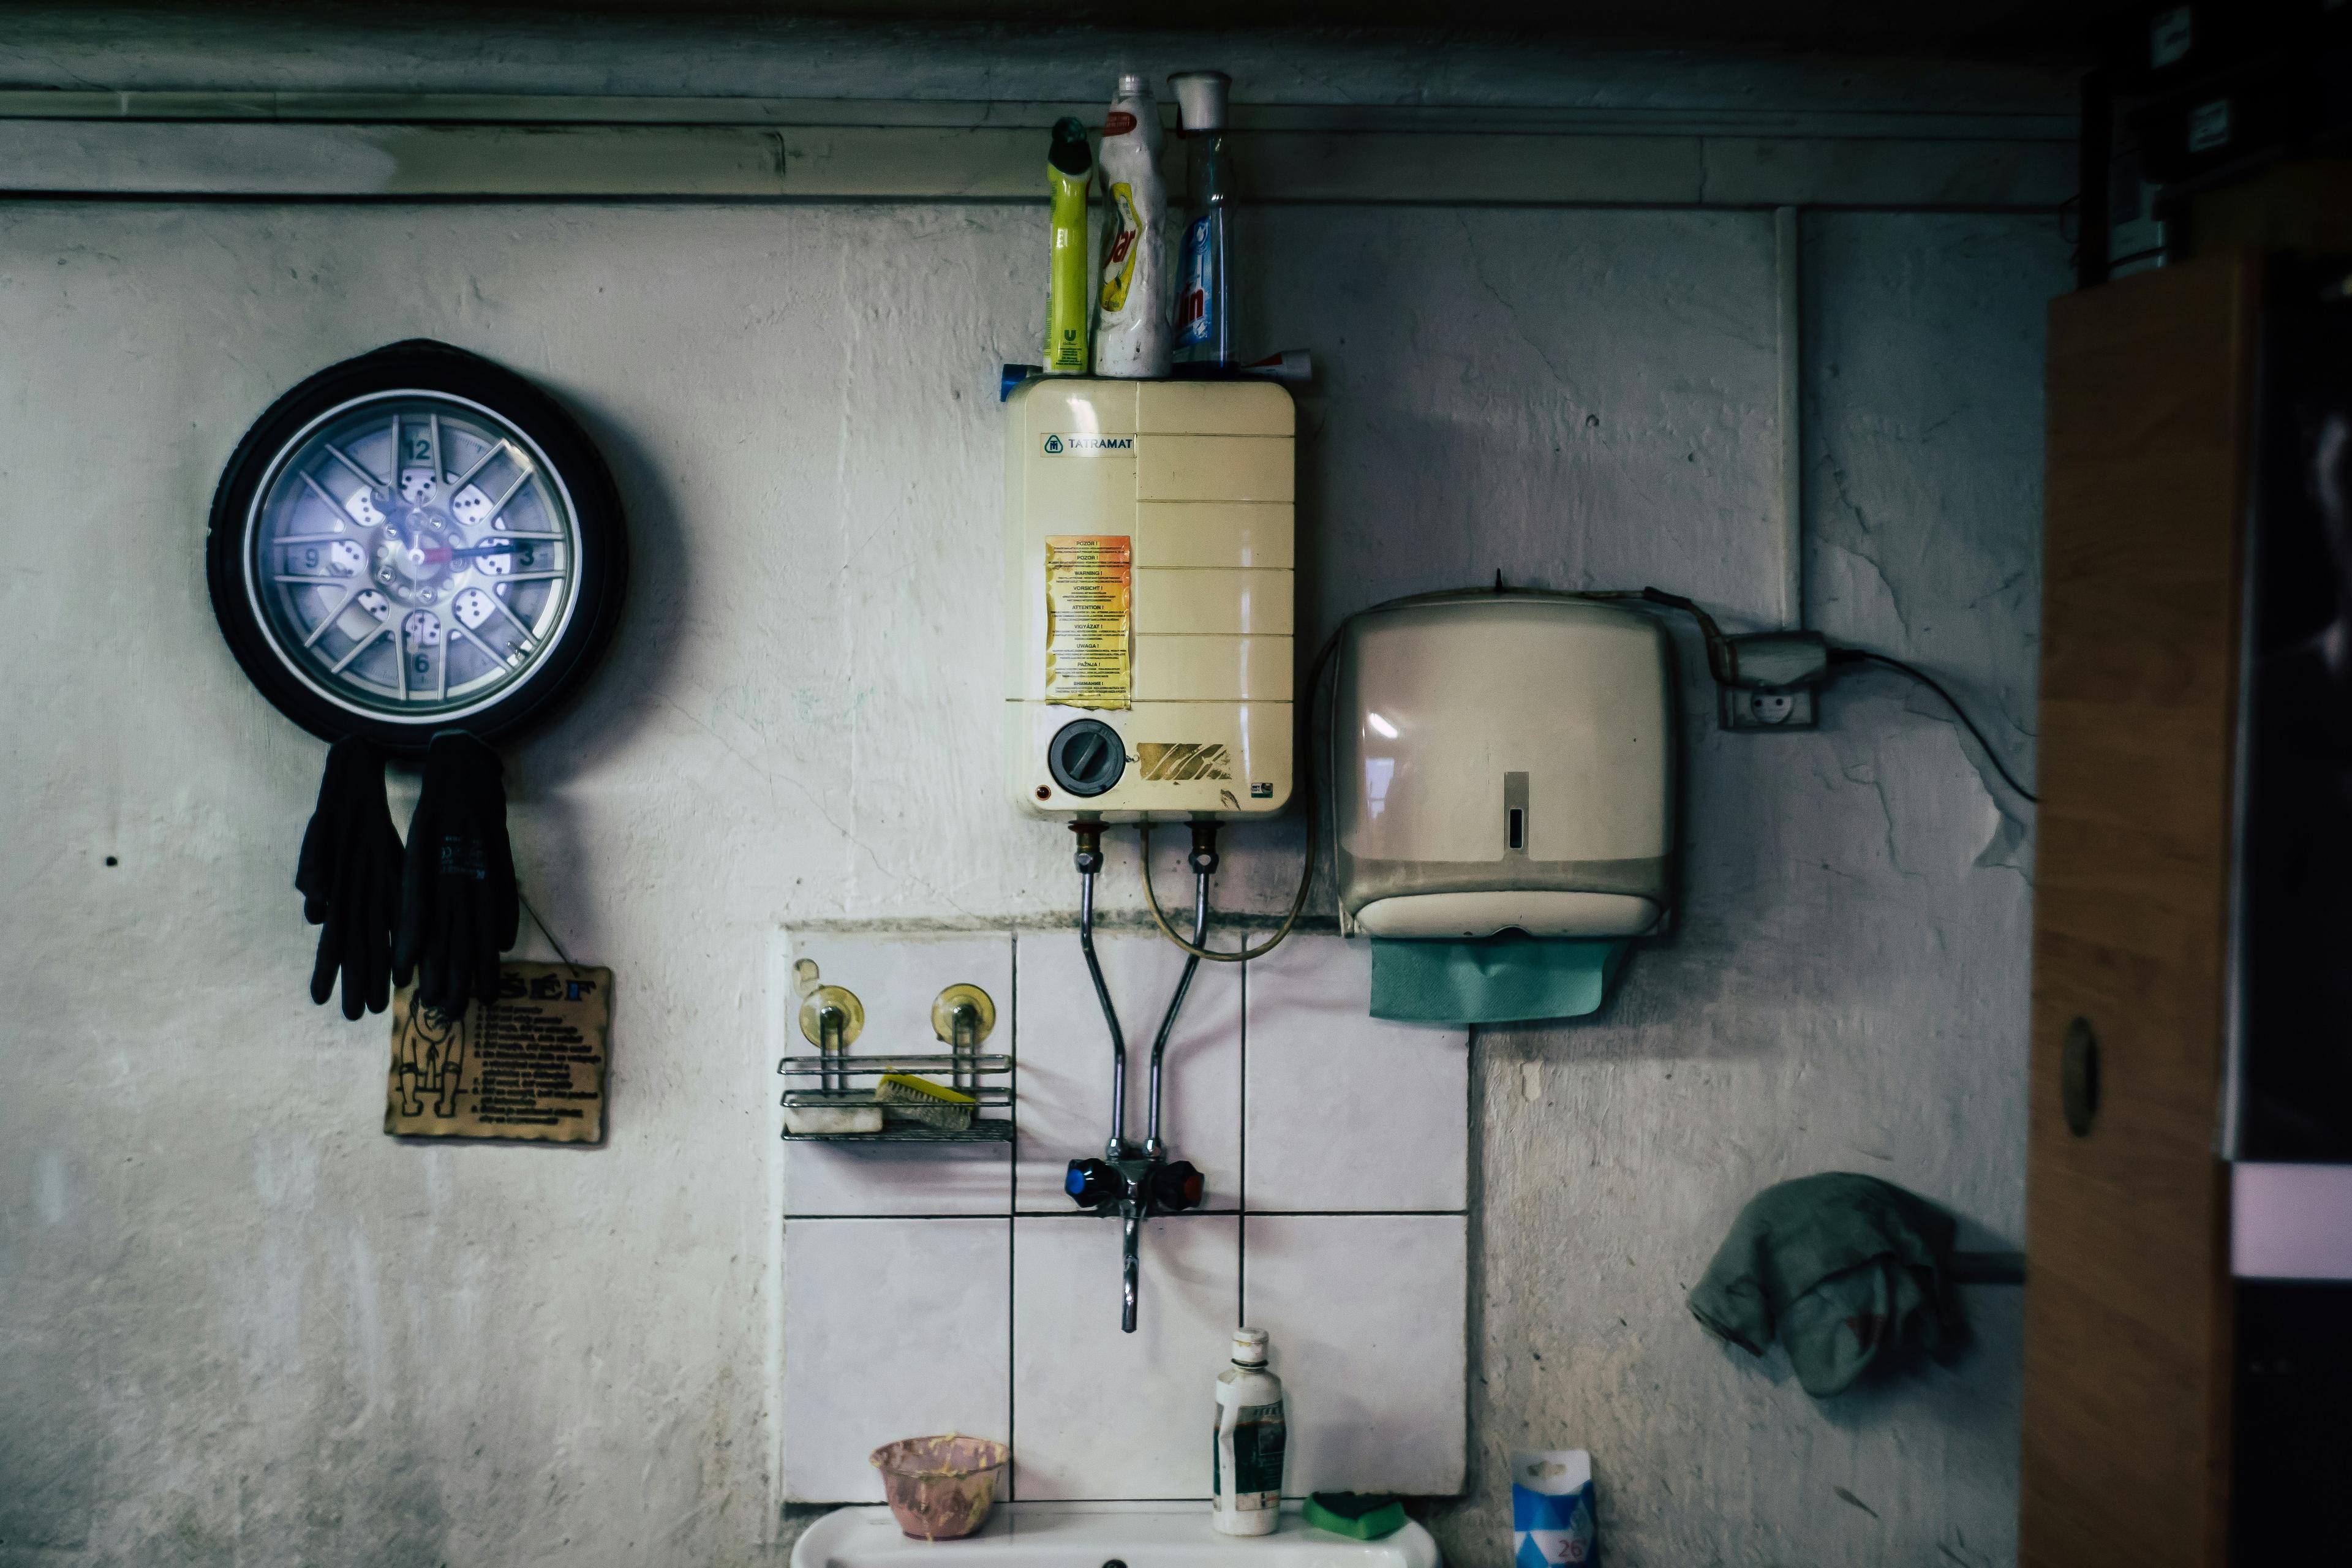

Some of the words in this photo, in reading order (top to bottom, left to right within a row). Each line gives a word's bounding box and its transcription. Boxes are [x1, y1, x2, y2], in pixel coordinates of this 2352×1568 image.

[407, 440, 431, 460] 12
[1068, 439, 1133, 448] TATRAMAT
[305, 550, 319, 568] 9
[415, 654, 429, 673] 6
